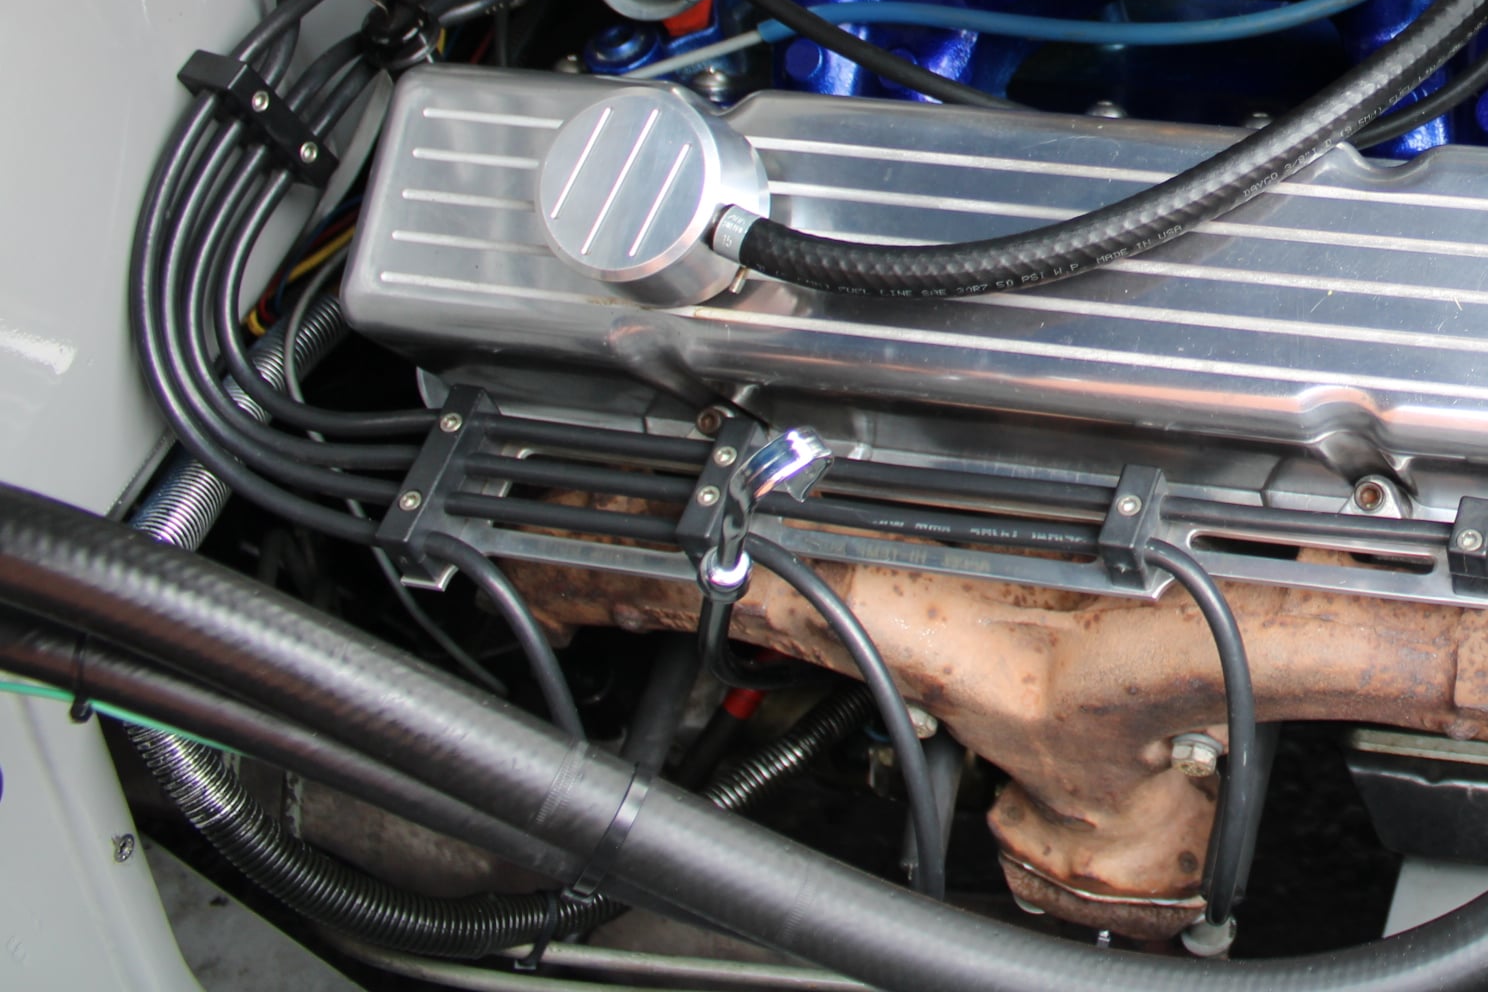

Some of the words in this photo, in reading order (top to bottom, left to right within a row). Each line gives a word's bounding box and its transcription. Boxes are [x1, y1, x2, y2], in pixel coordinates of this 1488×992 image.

[1021, 272, 1044, 283] PSI
[1096, 247, 1129, 264] MADE
[1136, 239, 1150, 250] IN
[1157, 224, 1182, 240] USA
